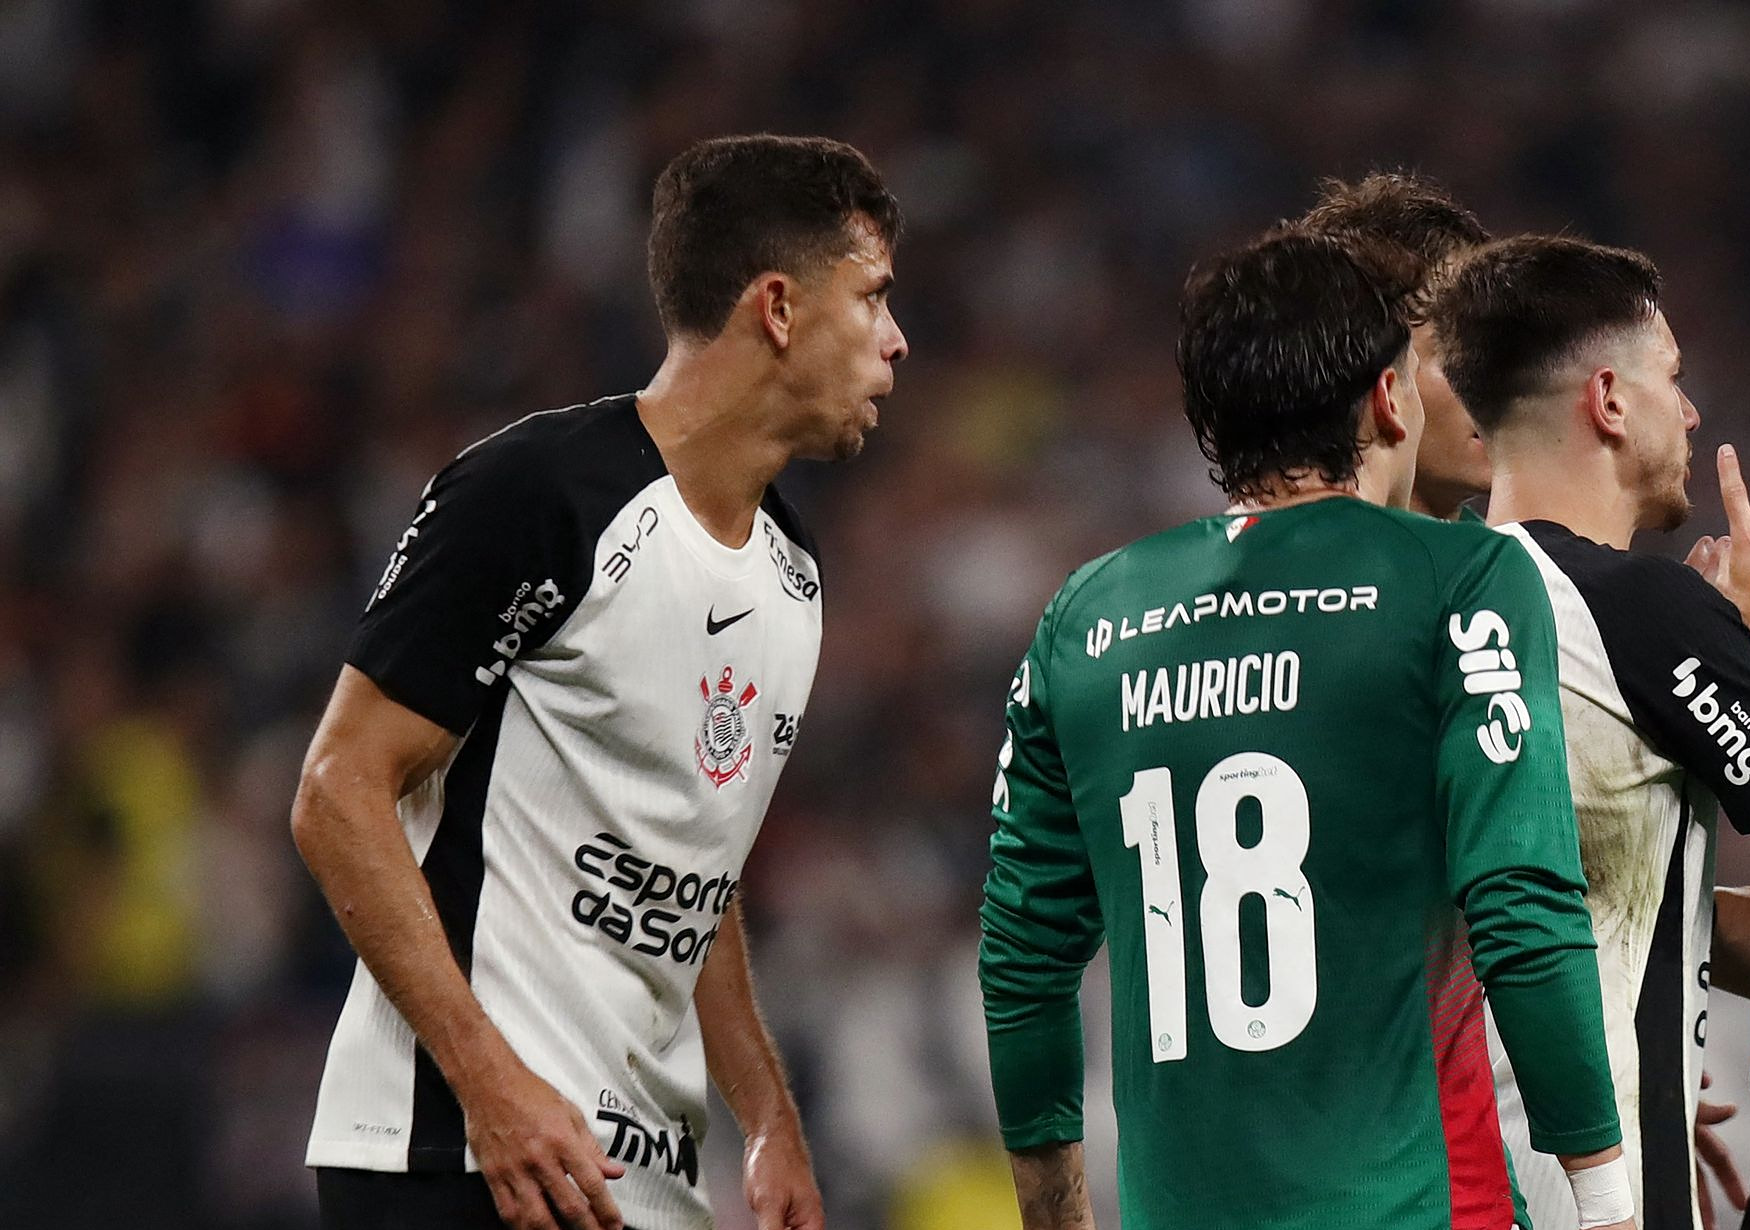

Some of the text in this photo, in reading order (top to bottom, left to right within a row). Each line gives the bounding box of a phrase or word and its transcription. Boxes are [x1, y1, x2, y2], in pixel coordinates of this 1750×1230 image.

[498, 582, 532, 623] banco
[1119, 585, 1379, 641] LEAPMOTOR
[1121, 650, 1300, 732] MAURICIO
[1118, 752, 1318, 1064] 18
